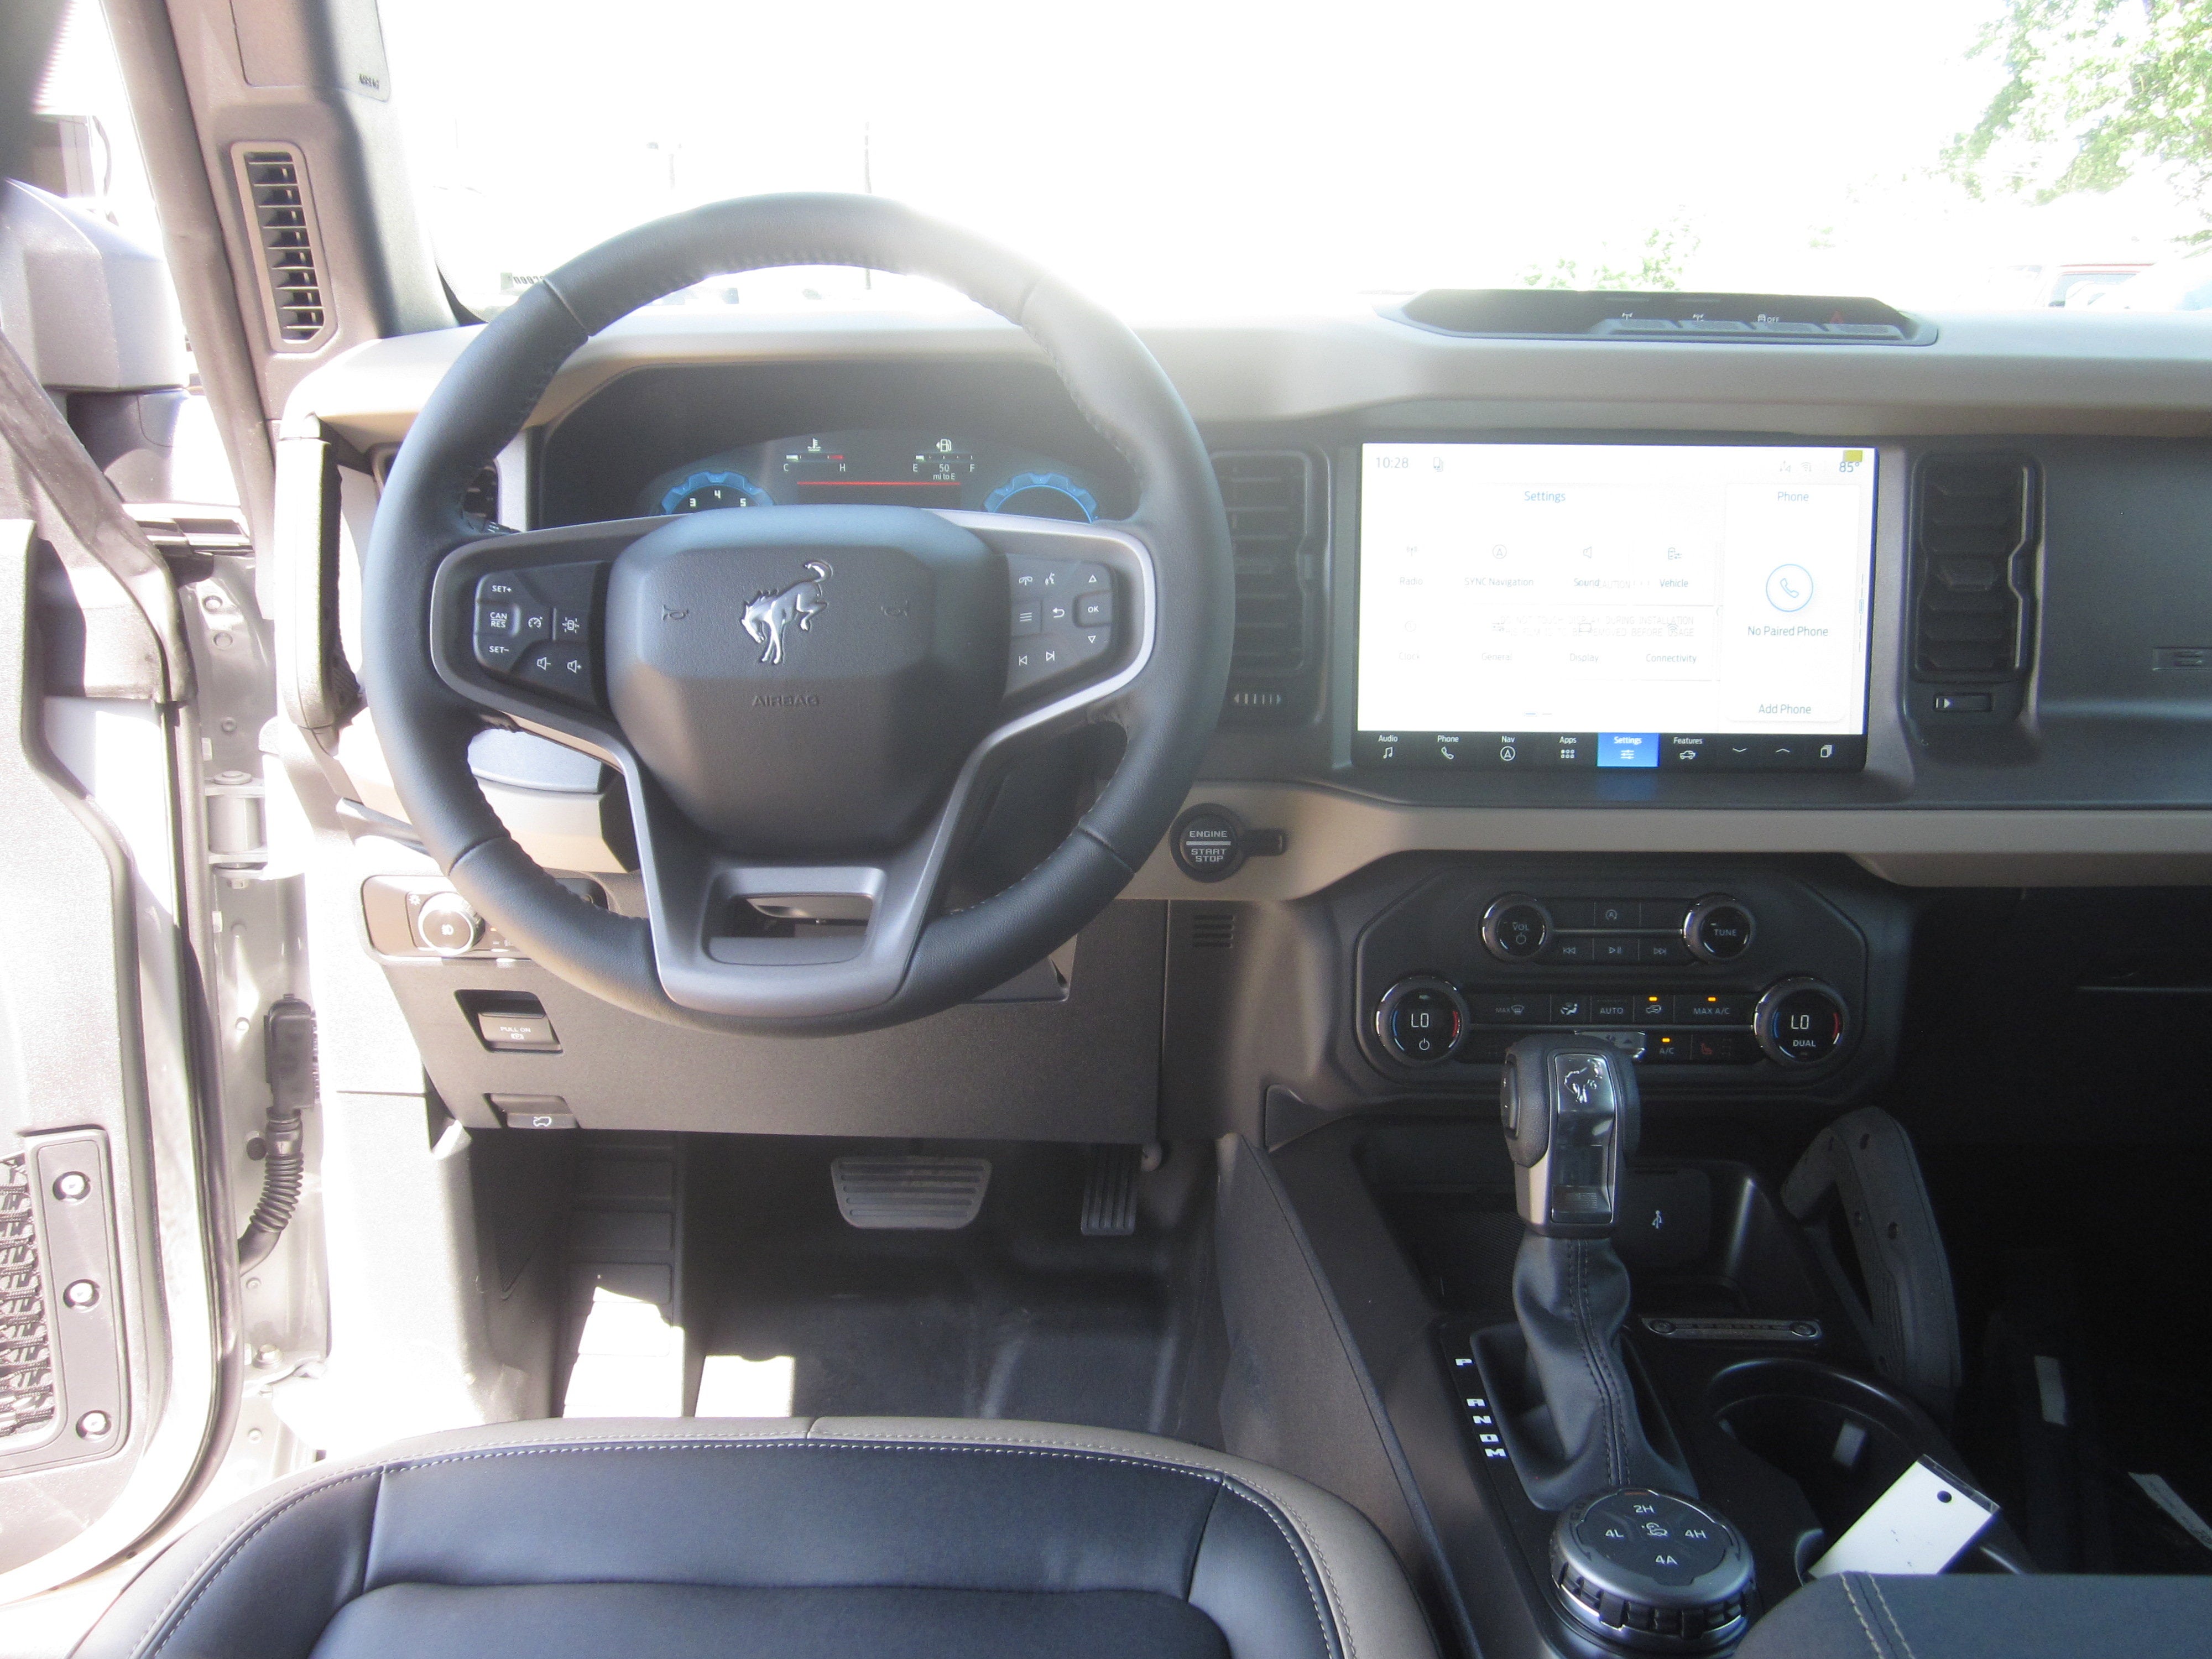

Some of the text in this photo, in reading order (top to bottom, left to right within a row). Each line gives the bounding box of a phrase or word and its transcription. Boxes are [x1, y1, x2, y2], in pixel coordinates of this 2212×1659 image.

[783, 463, 789, 472] C
[839, 463, 846, 472] H
[1376, 457, 1410, 469] 10:28
[714, 490, 721, 499] 4
[1524, 491, 1566, 503] Settings
[1777, 492, 1809, 502] Phone
[690, 498, 696, 507] 3
[740, 498, 747, 507] 5
[1399, 576, 1423, 586] Radio
[1464, 577, 1535, 588] SYNC Navigation
[1574, 578, 1600, 588] Sound
[1659, 578, 1689, 588] Vehicle
[490, 612, 507, 620] CAN
[1747, 625, 1829, 637] No Paired Phone
[1399, 651, 1420, 661] Clock
[1481, 651, 1512, 661] General
[1569, 653, 1599, 664] Display
[1646, 653, 1698, 664] Connectivity
[752, 694, 820, 707] AIRBAG
[1759, 704, 1812, 714] Add Phone
[1559, 736, 1577, 745] Apps
[1614, 736, 1642, 745] Settings
[1673, 737, 1703, 745] Features
[1599, 1006, 1624, 1015] AUTO
[1411, 1013, 1430, 1028] LO
[1791, 1014, 1809, 1030] LO
[1455, 1358, 1473, 1366] P
[1473, 1416, 1492, 1424] N
[1479, 1434, 1499, 1442] D
[1485, 1448, 1506, 1457] M
[1633, 1504, 1655, 1514] 2H
[1605, 1528, 1624, 1538] 4L
[1684, 1530, 1707, 1539] 4H
[1655, 1554, 1678, 1564] 4A
